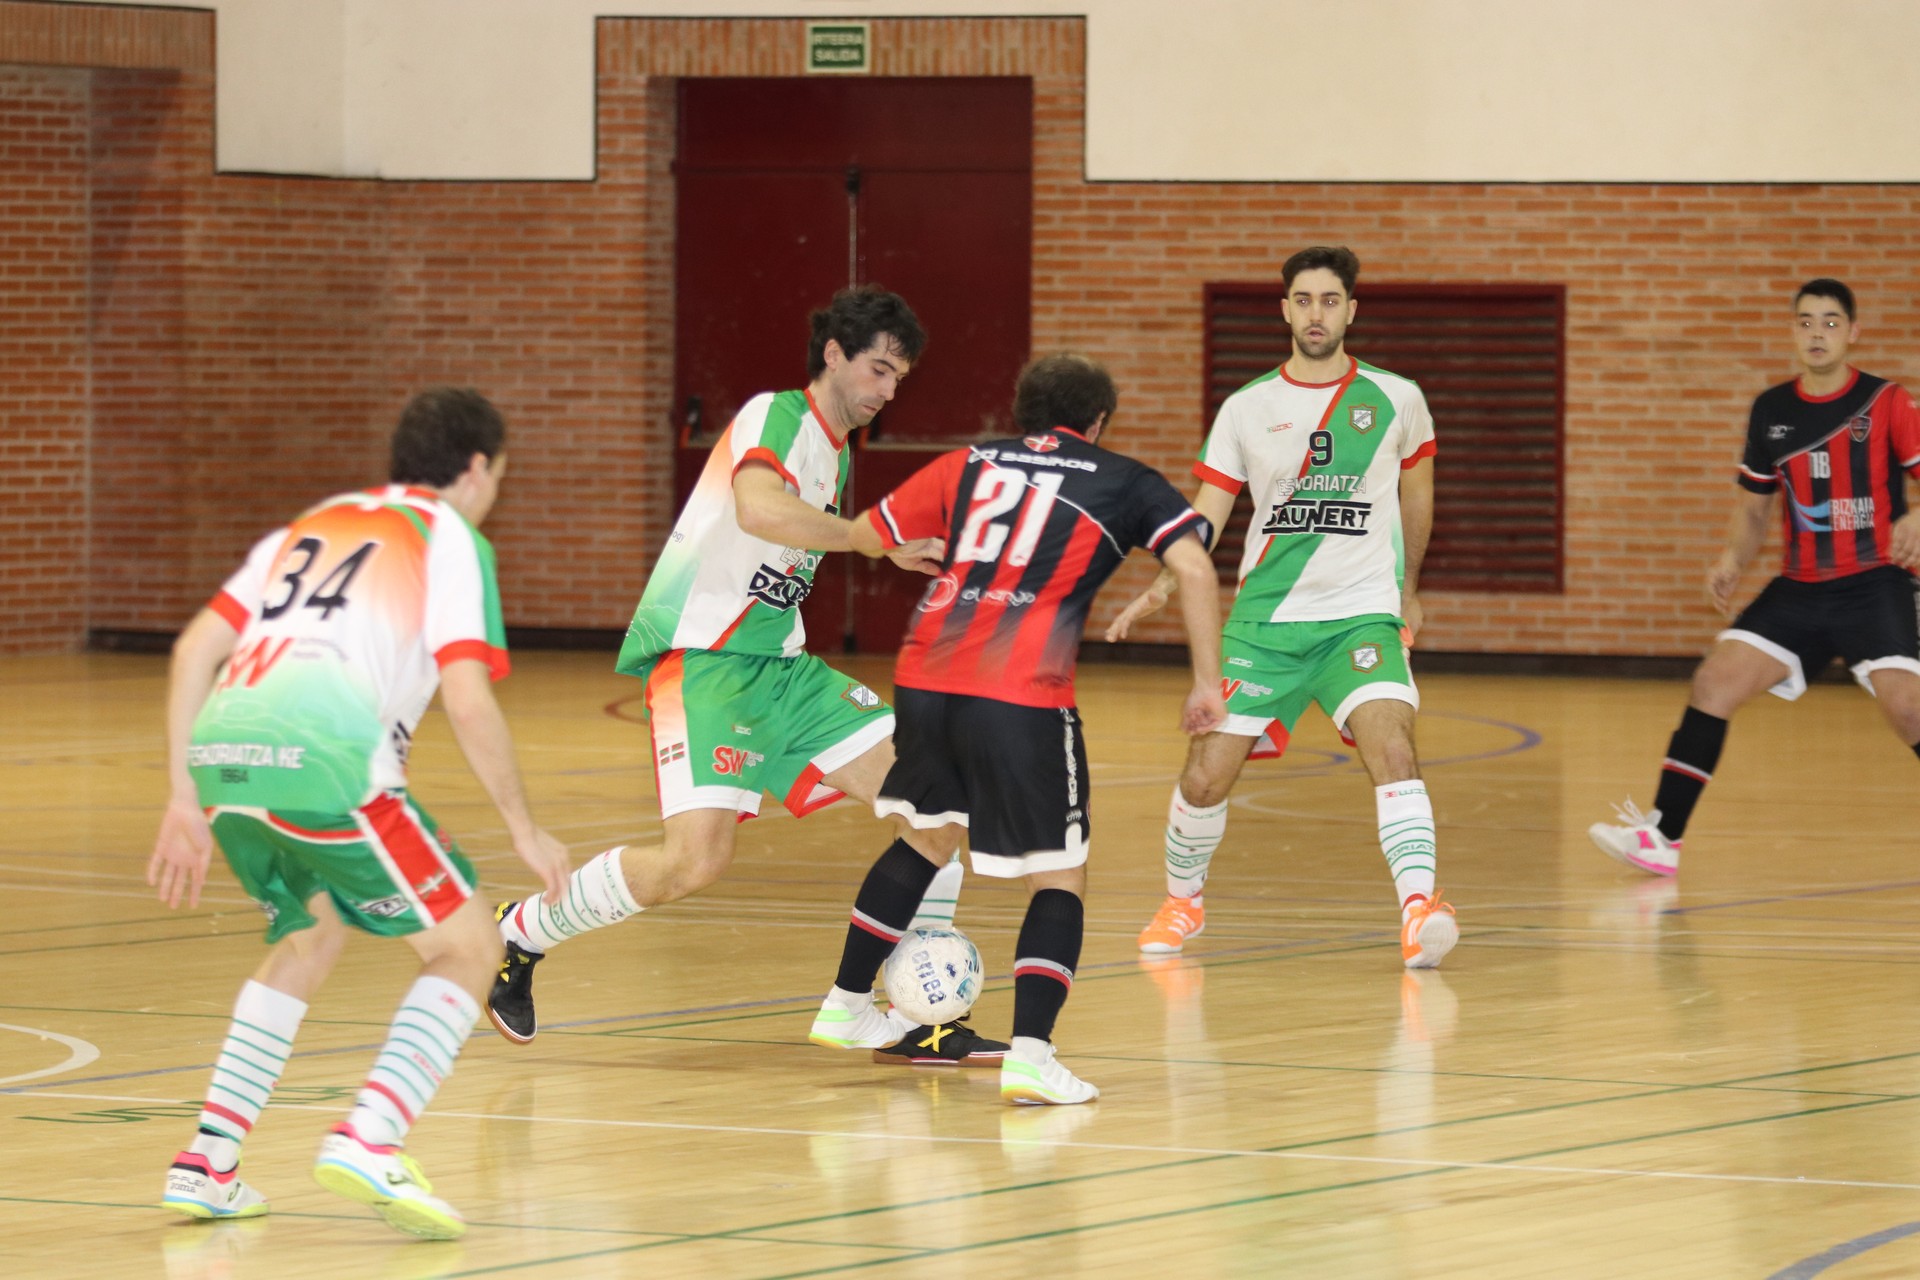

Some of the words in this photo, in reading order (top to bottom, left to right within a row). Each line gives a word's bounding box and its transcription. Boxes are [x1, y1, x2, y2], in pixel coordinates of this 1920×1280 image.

[1309, 429, 1334, 467] 9
[1809, 451, 1832, 479] 18
[1276, 474, 1367, 497] ESKORIATZA
[956, 467, 1064, 567] 21
[1832, 497, 1875, 516] BIZKAIA
[1833, 512, 1875, 532] ENERGIA
[261, 537, 378, 621] 34
[712, 745, 749, 777] SW
